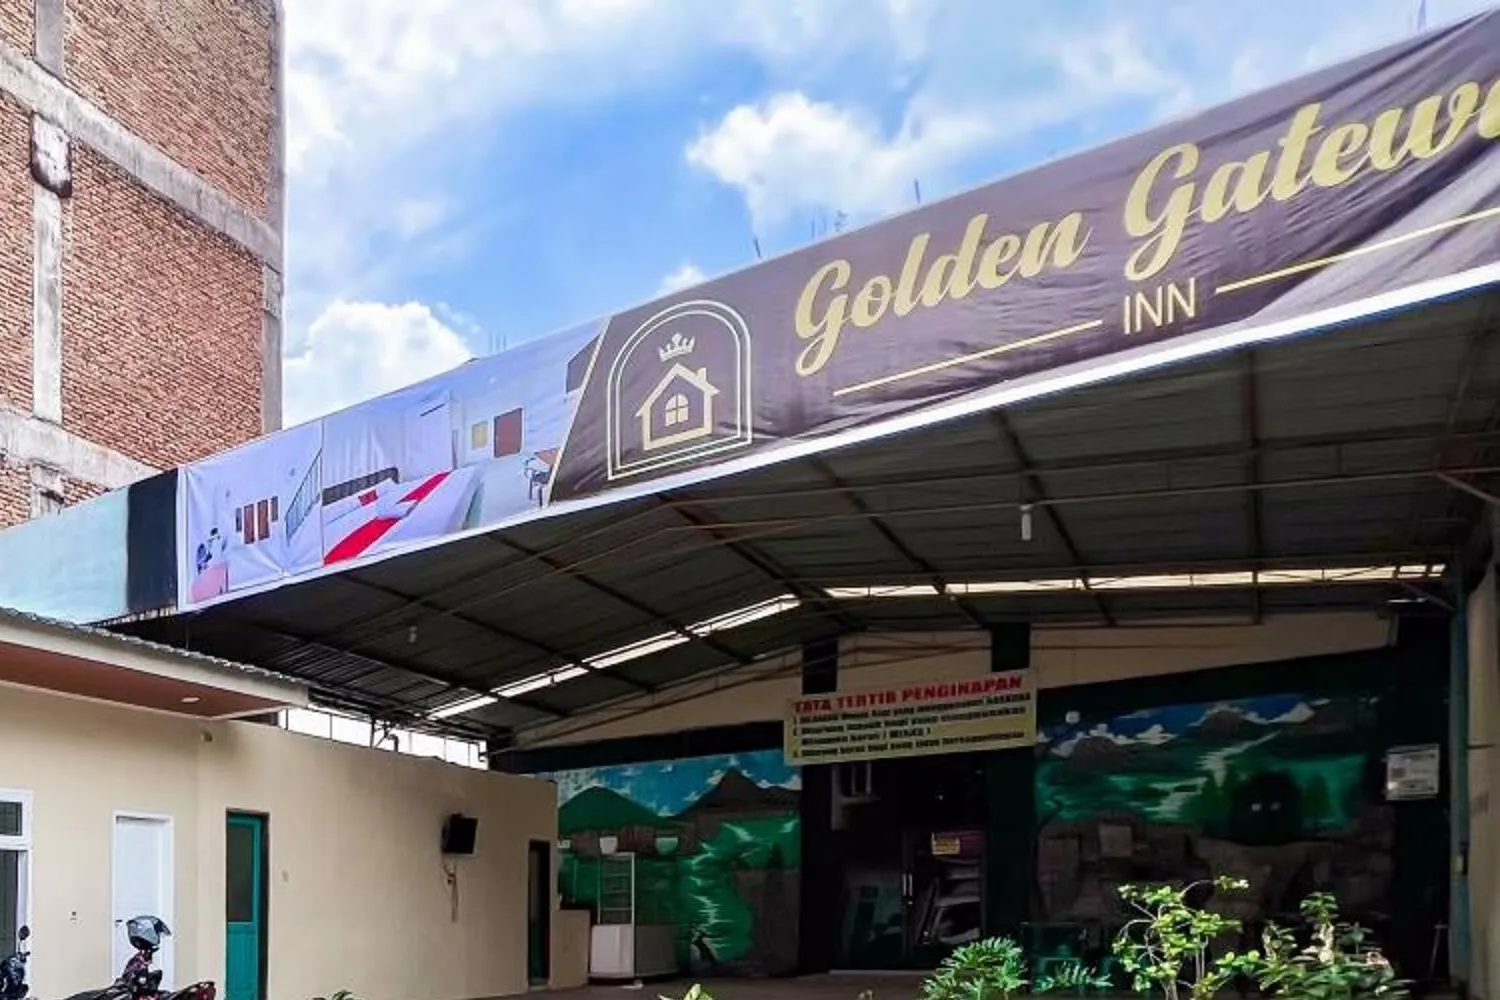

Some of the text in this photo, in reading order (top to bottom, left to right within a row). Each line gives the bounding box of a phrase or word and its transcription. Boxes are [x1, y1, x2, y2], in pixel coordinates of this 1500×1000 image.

[795, 212, 1092, 376] Golden
[1124, 278, 1196, 334] INN
[795, 701, 831, 714] TATA
[837, 691, 897, 709] TERTIB
[902, 676, 1022, 702] PENGINAPAN
